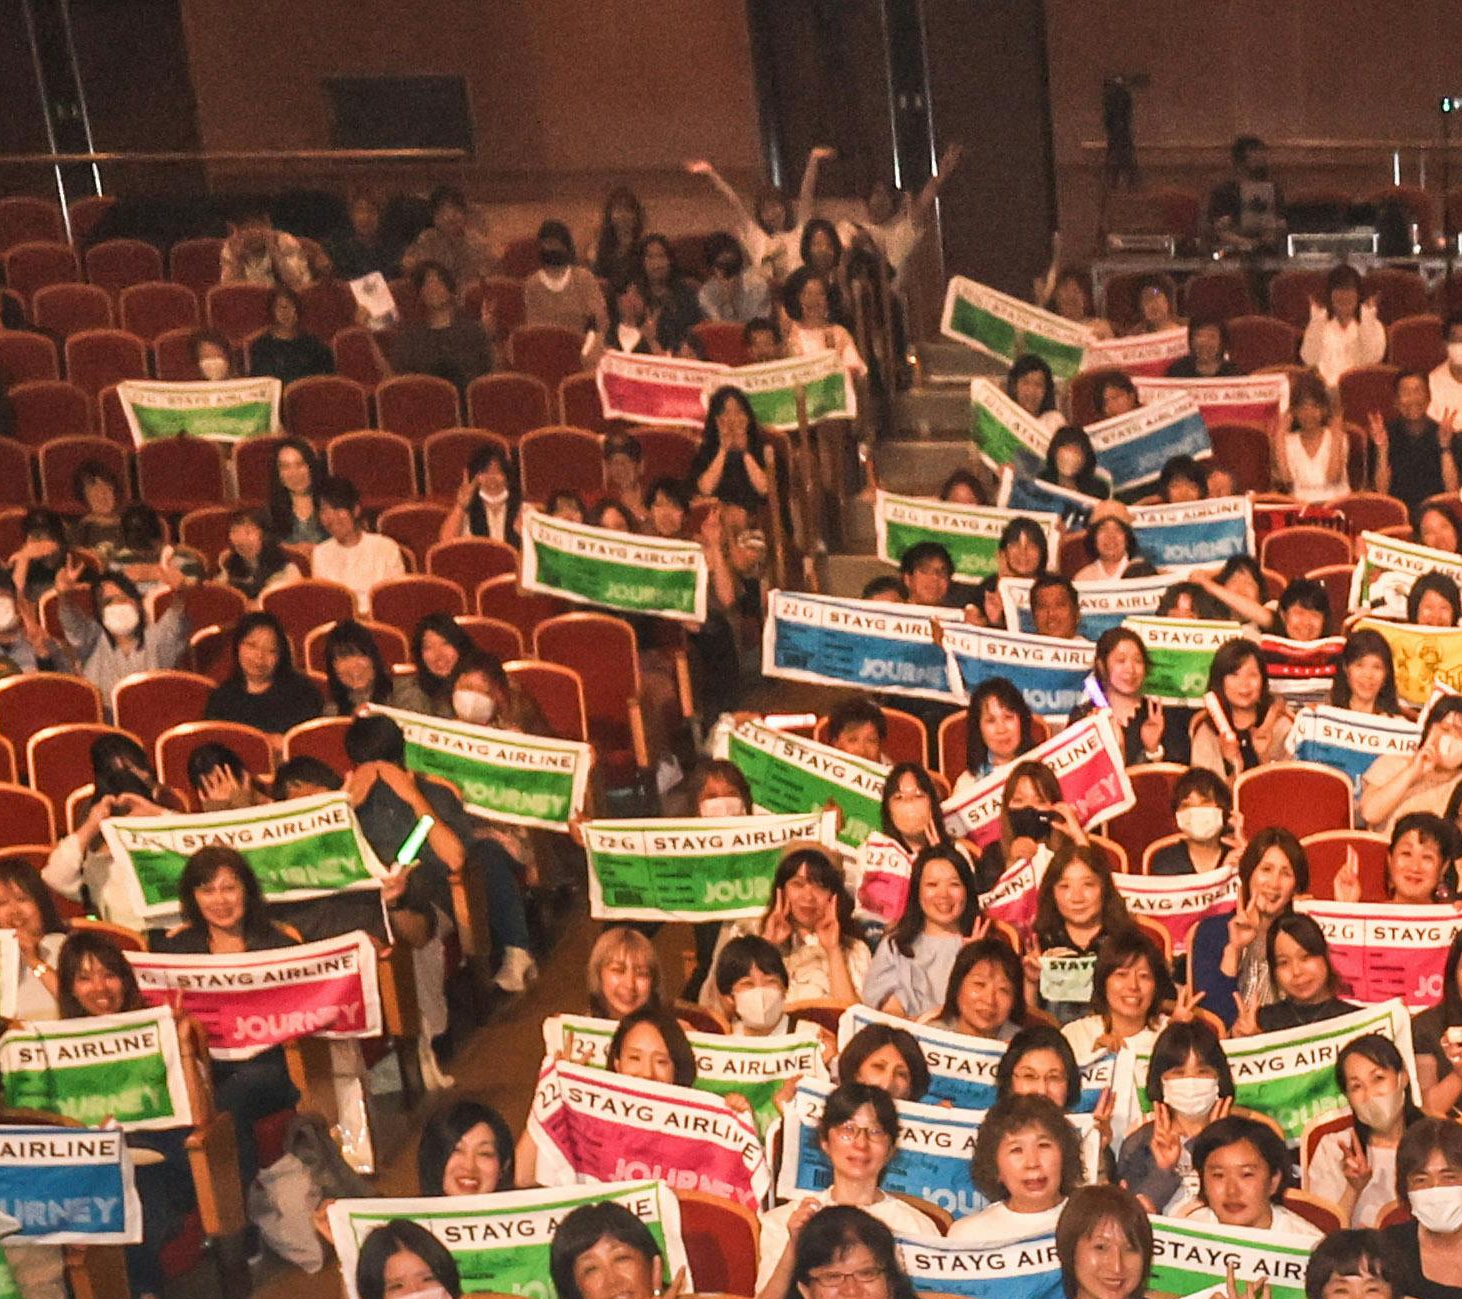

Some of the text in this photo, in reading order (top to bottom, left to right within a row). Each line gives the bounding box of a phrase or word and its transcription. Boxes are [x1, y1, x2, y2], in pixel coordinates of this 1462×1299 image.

[830, 611, 887, 632] STAYG
[428, 731, 572, 768] STAYG AIRLINE
[654, 824, 818, 851] STAYG AIRLINE
[177, 954, 354, 990] STAYG AIRLINE
[568, 1085, 654, 1122] STAYG
